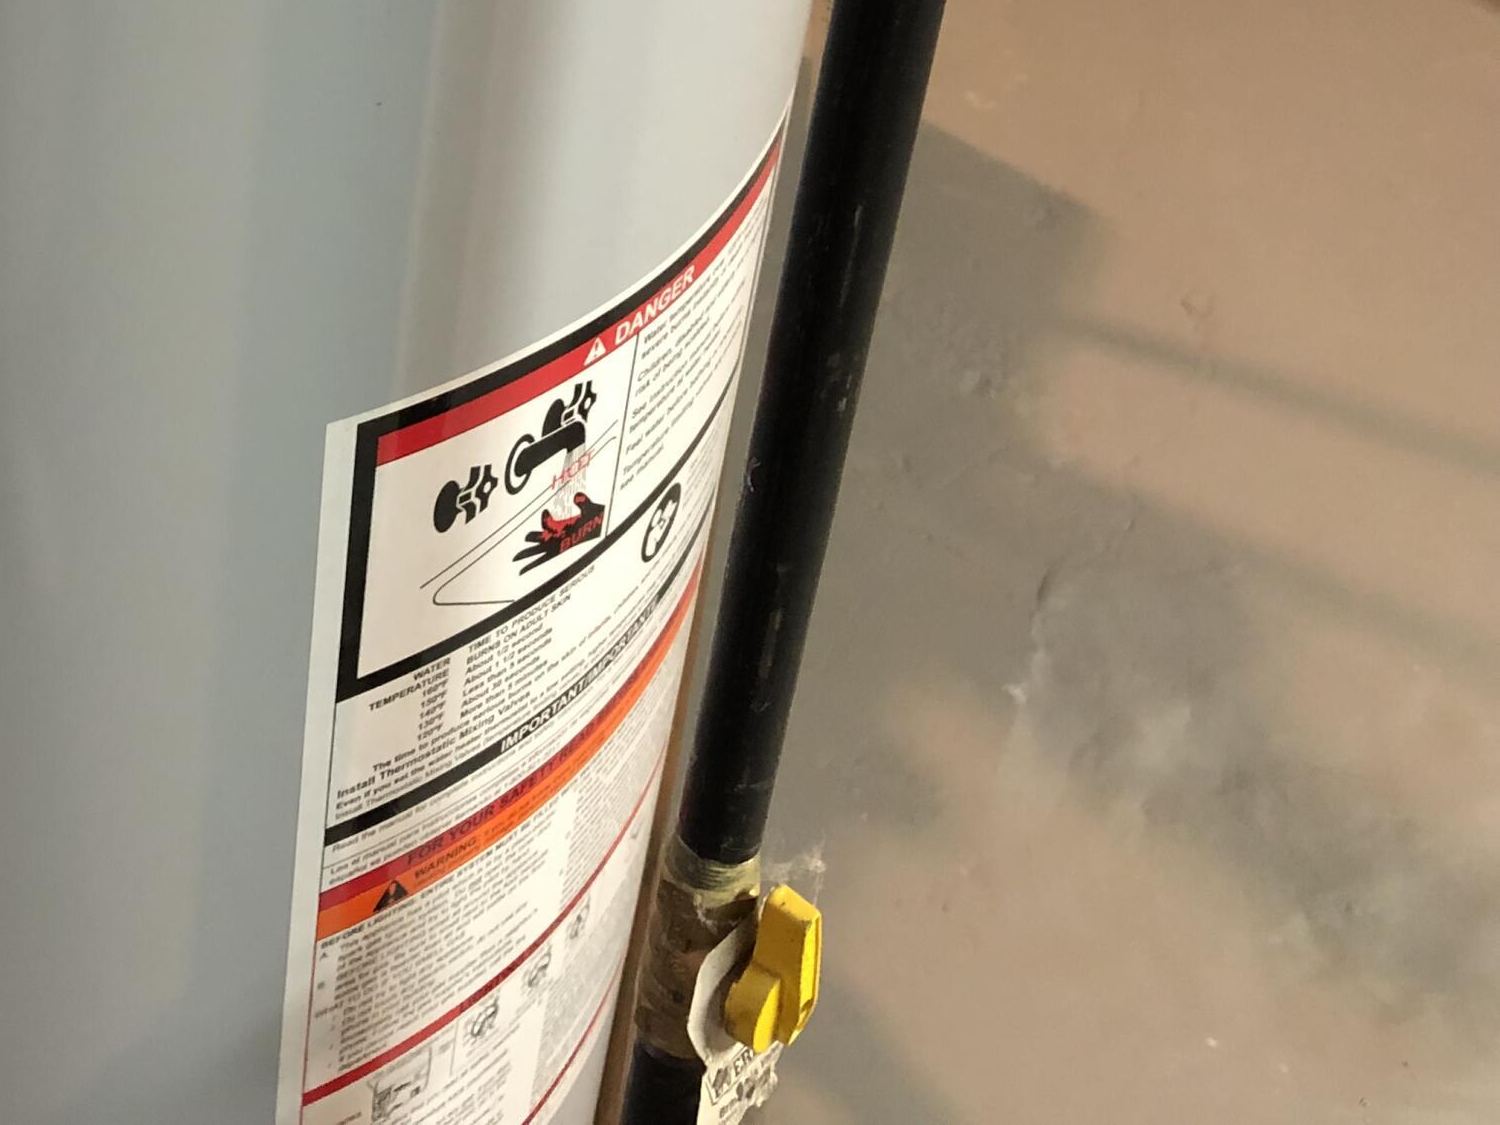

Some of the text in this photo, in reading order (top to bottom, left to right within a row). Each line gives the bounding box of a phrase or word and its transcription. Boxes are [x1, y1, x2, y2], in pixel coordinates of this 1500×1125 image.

[615, 264, 696, 345] DANGER
[560, 516, 601, 554] BURN
[466, 640, 501, 665] BURNS
[503, 630, 518, 643] ON
[520, 609, 549, 635] ADULT
[469, 635, 491, 653] TIME
[496, 626, 509, 639] TO
[512, 594, 556, 628] PRODUCE
[413, 657, 451, 680] WATER
[464, 665, 492, 686] About
[466, 655, 493, 675] About
[369, 668, 450, 711] TEMPERATURE
[461, 687, 489, 708] About
[462, 681, 484, 697] Less
[460, 702, 483, 719] More
[337, 690, 531, 798] Install Thermostatic Mixing Valves
[373, 760, 392, 772] The
[336, 792, 361, 810] Even
[406, 838, 445, 865] FOR
[448, 805, 495, 843] YOUR
[414, 837, 477, 879] WARNING
